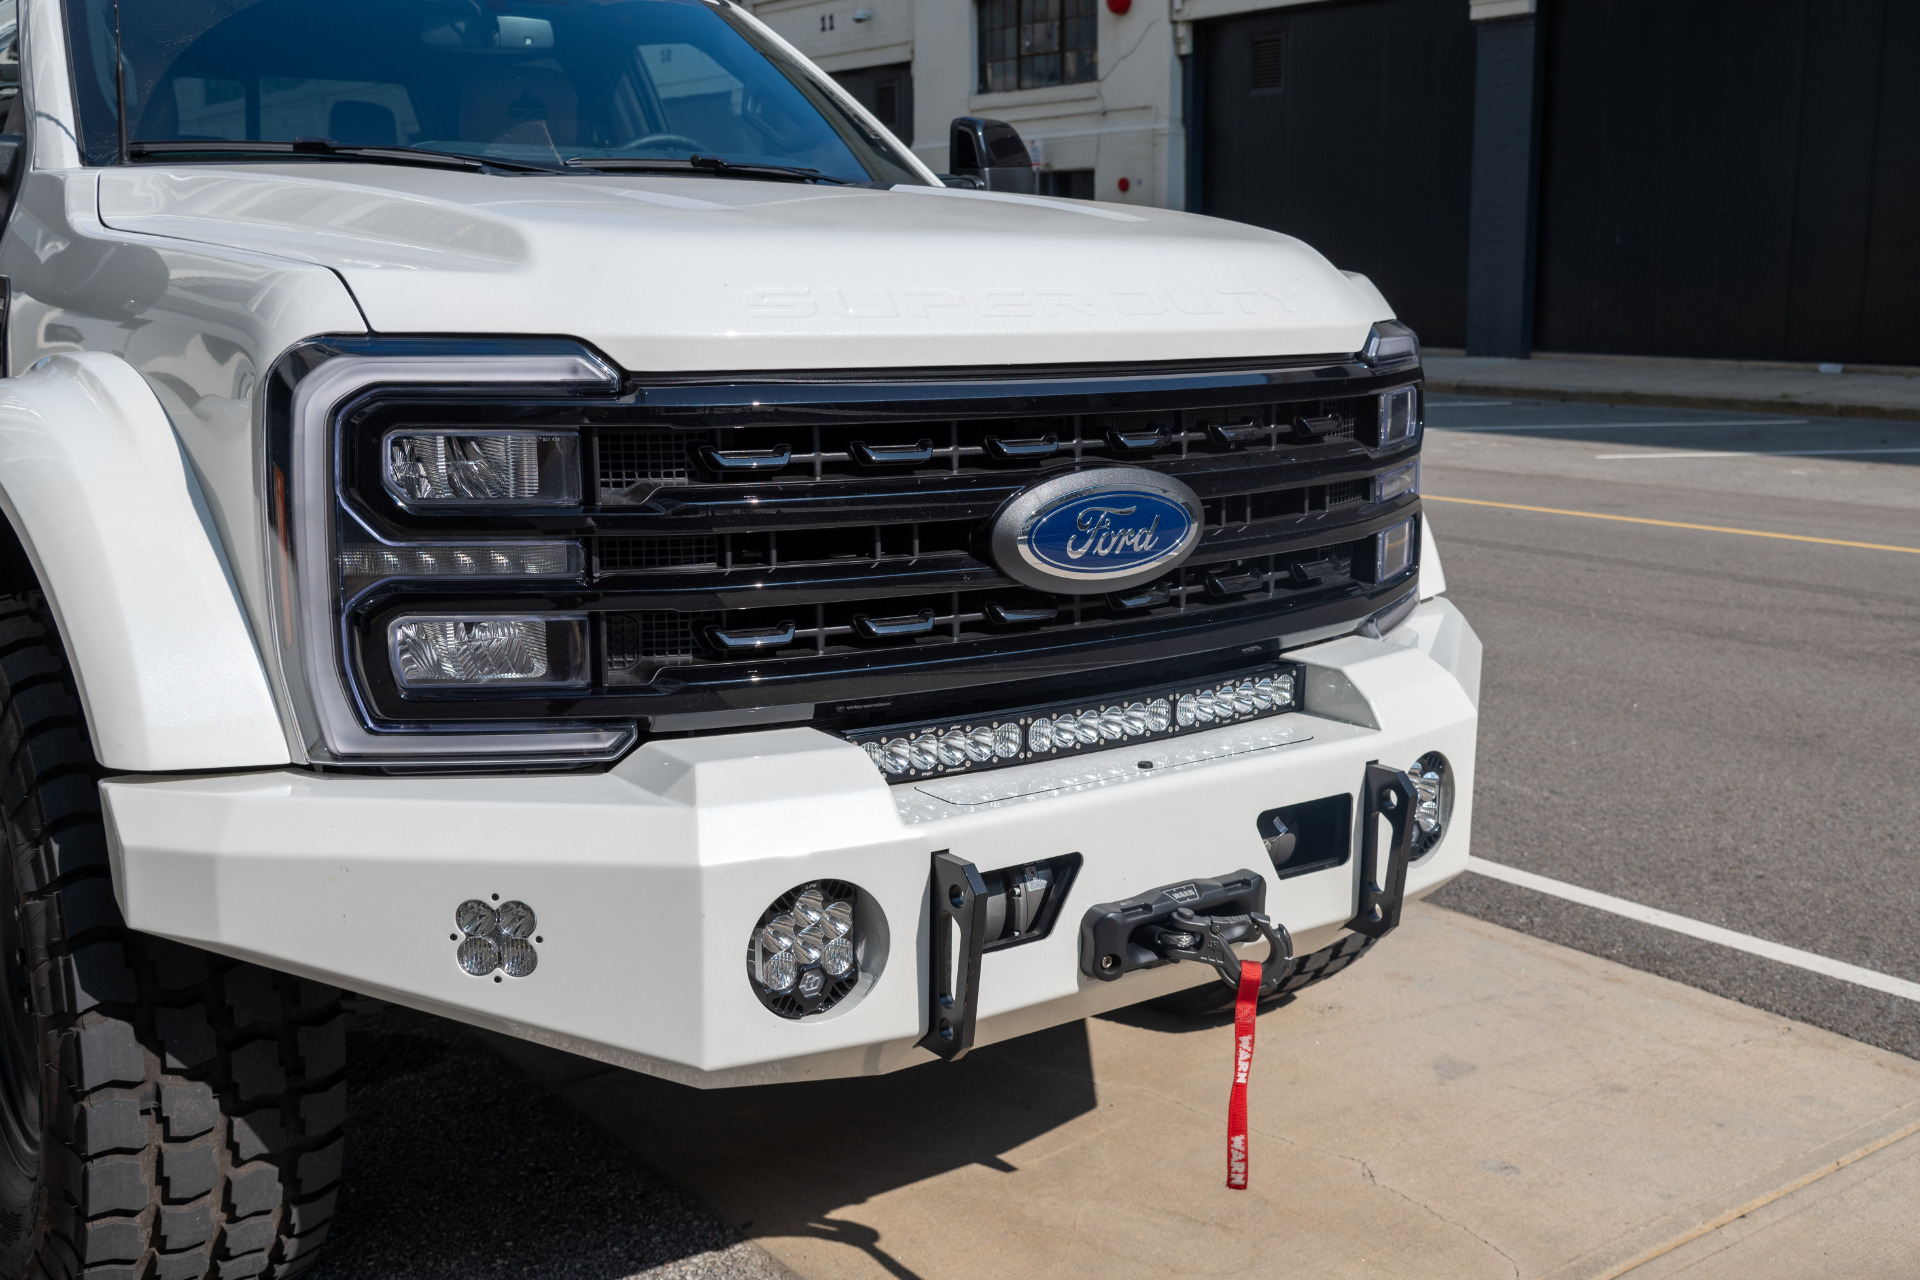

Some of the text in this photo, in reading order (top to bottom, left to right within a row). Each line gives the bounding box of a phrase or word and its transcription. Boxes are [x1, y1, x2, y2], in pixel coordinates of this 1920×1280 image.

[820, 13, 835, 32] 11
[743, 287, 1300, 319] SUPER DUTY
[1066, 505, 1161, 559] Ford
[1171, 889, 1196, 900] WARN
[1236, 1035, 1252, 1084] WARN
[1230, 1134, 1246, 1186] WARN
